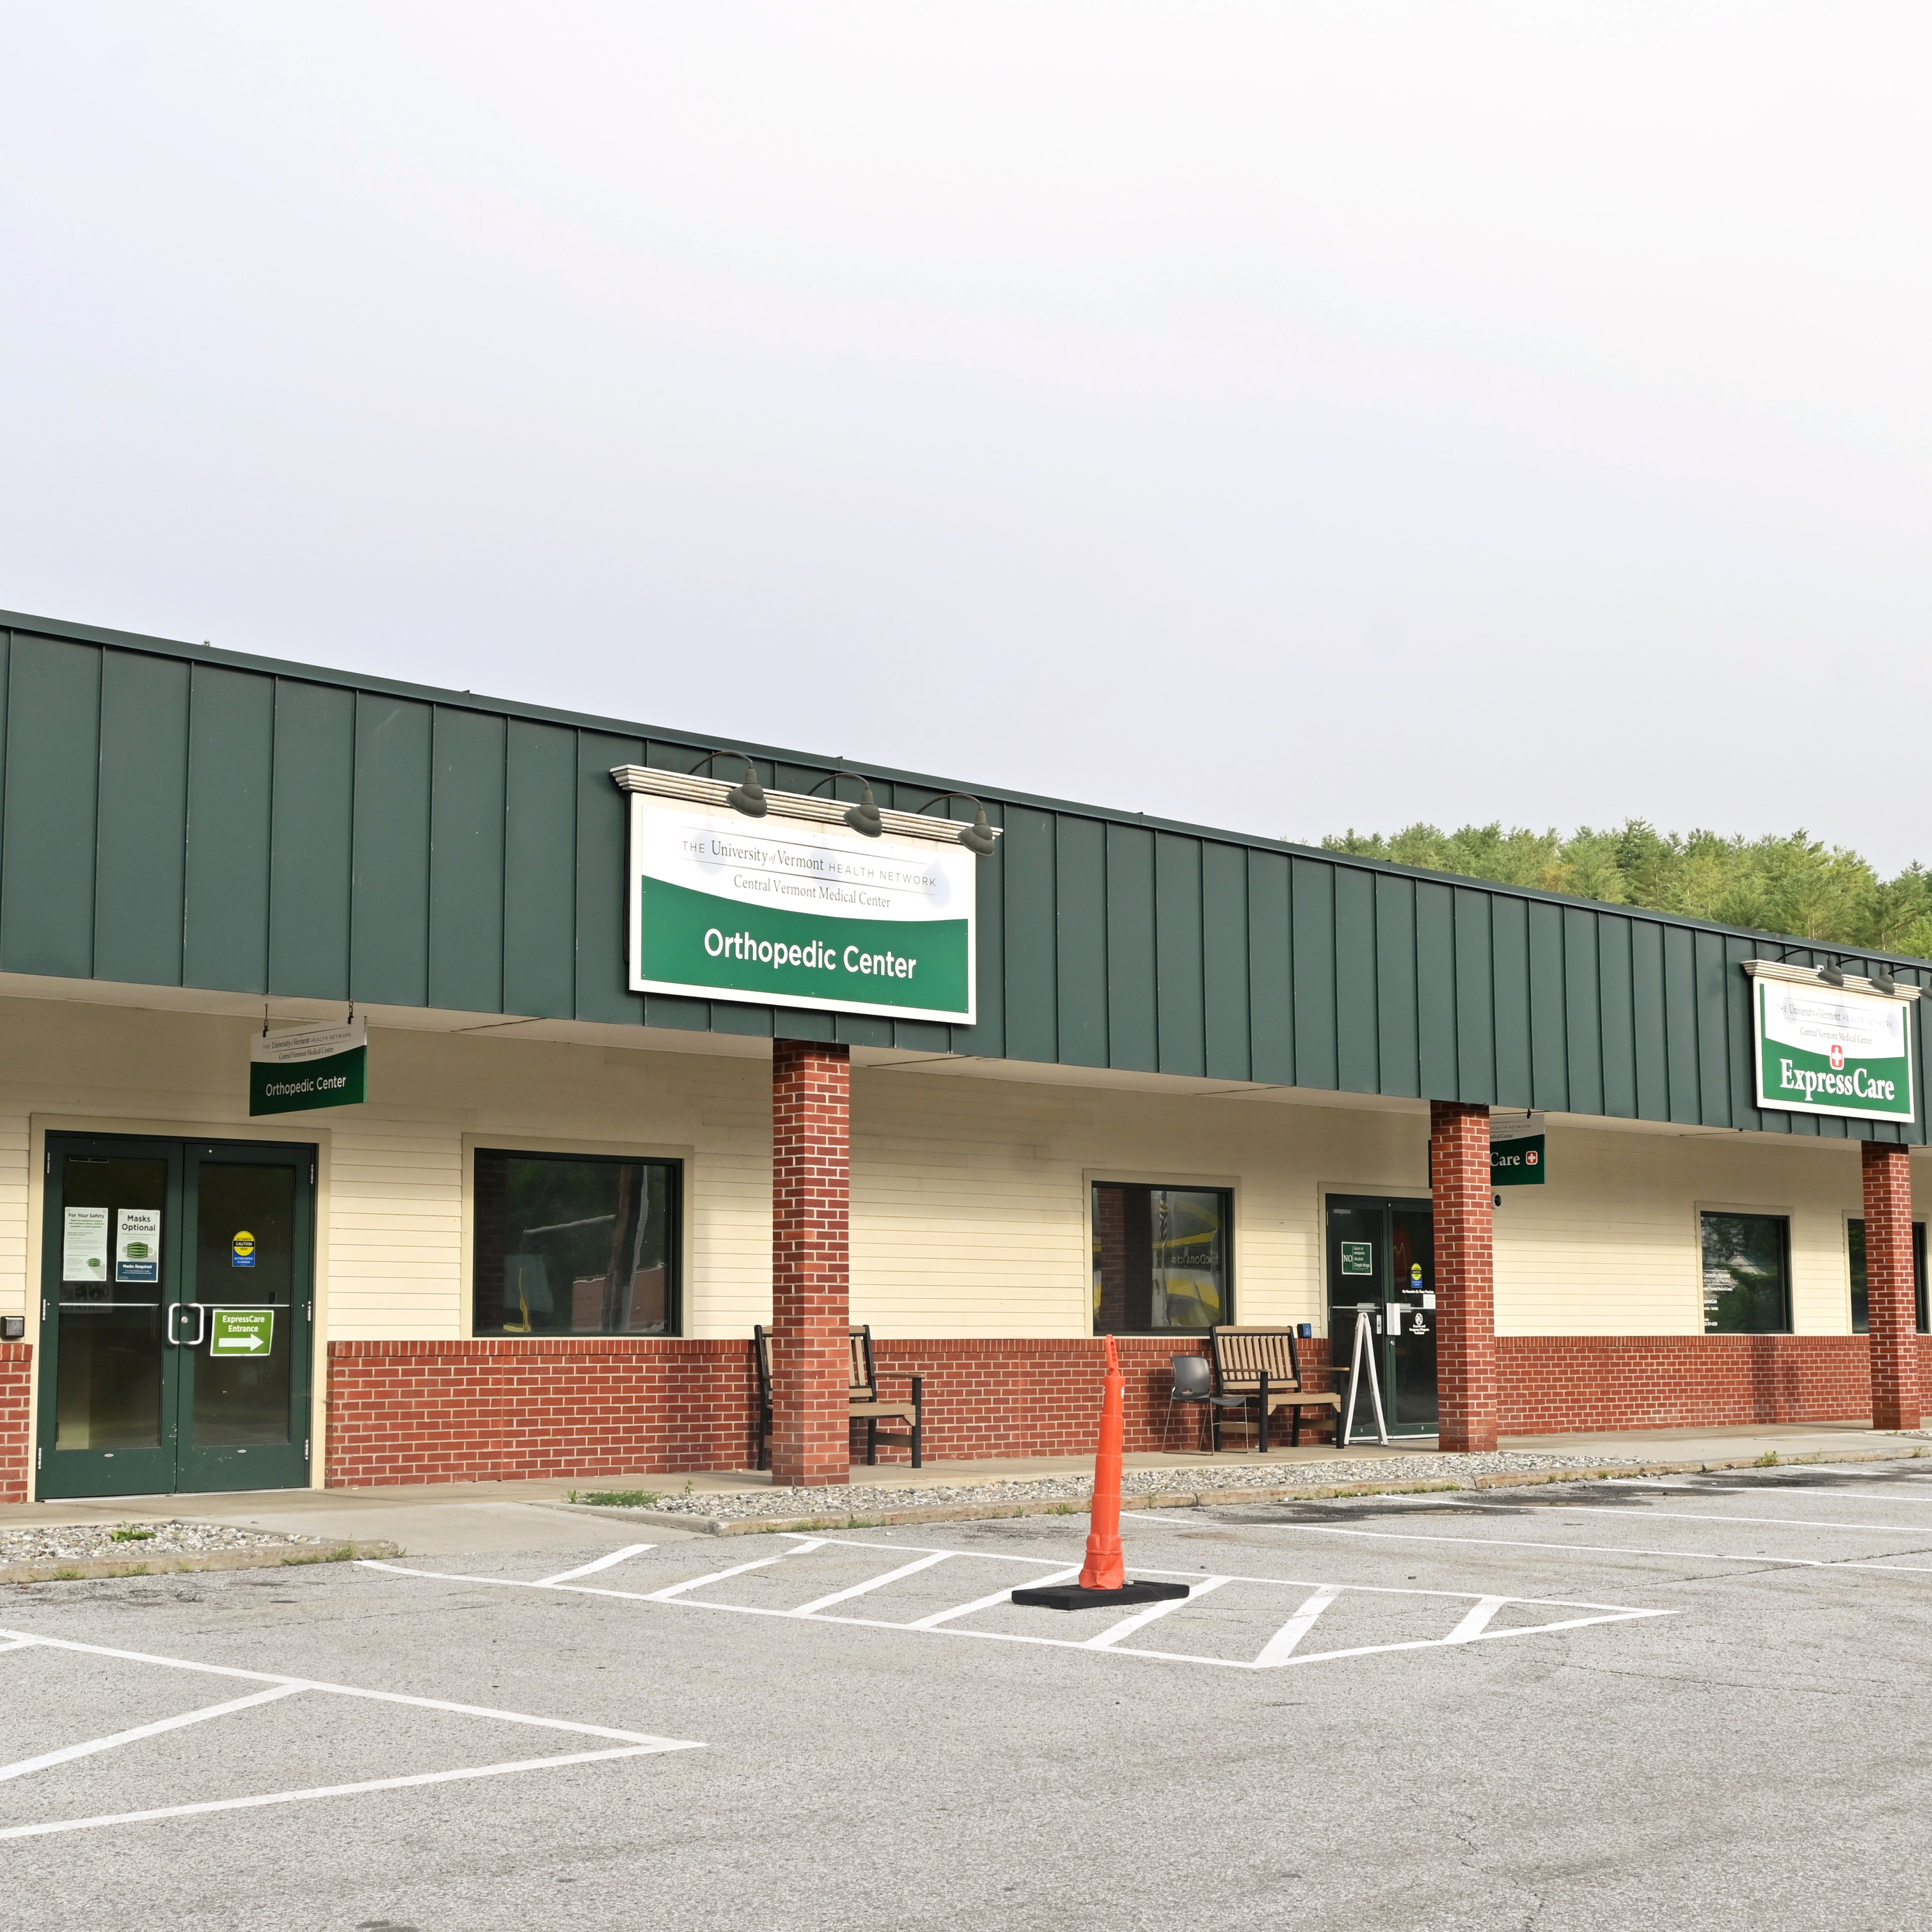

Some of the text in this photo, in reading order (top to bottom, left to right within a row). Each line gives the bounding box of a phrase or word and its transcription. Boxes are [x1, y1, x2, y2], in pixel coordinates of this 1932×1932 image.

[682, 840, 936, 887] THE University of Vermont HEALTH NETWORK
[734, 874, 891, 908] Central Vermont Medical Center
[704, 928, 917, 979] Orthopedic Center
[1777, 1005, 1787, 1013] THE
[1789, 1004, 1815, 1020] University
[1819, 1008, 1841, 1021] Vermont
[1843, 1015, 1864, 1024] HEALTH
[1866, 1018, 1893, 1028] NETWORK
[272, 1040, 291, 1049] University
[293, 1037, 310, 1045] Vermont
[1800, 1026, 1872, 1044] Central Vermont Medical Center
[279, 1051, 291, 1060] Central
[291, 1050, 306, 1058] Vermont
[307, 1047, 321, 1055] Medical
[266, 1075, 346, 1096] Orthopedic Center
[1779, 1058, 1895, 1101] ExpressCare
[122, 1223, 155, 1232] Optional
[1344, 1254, 1352, 1262] NO
[222, 1315, 265, 1324] ExpressCare
[228, 1325, 259, 1333] Entrance
